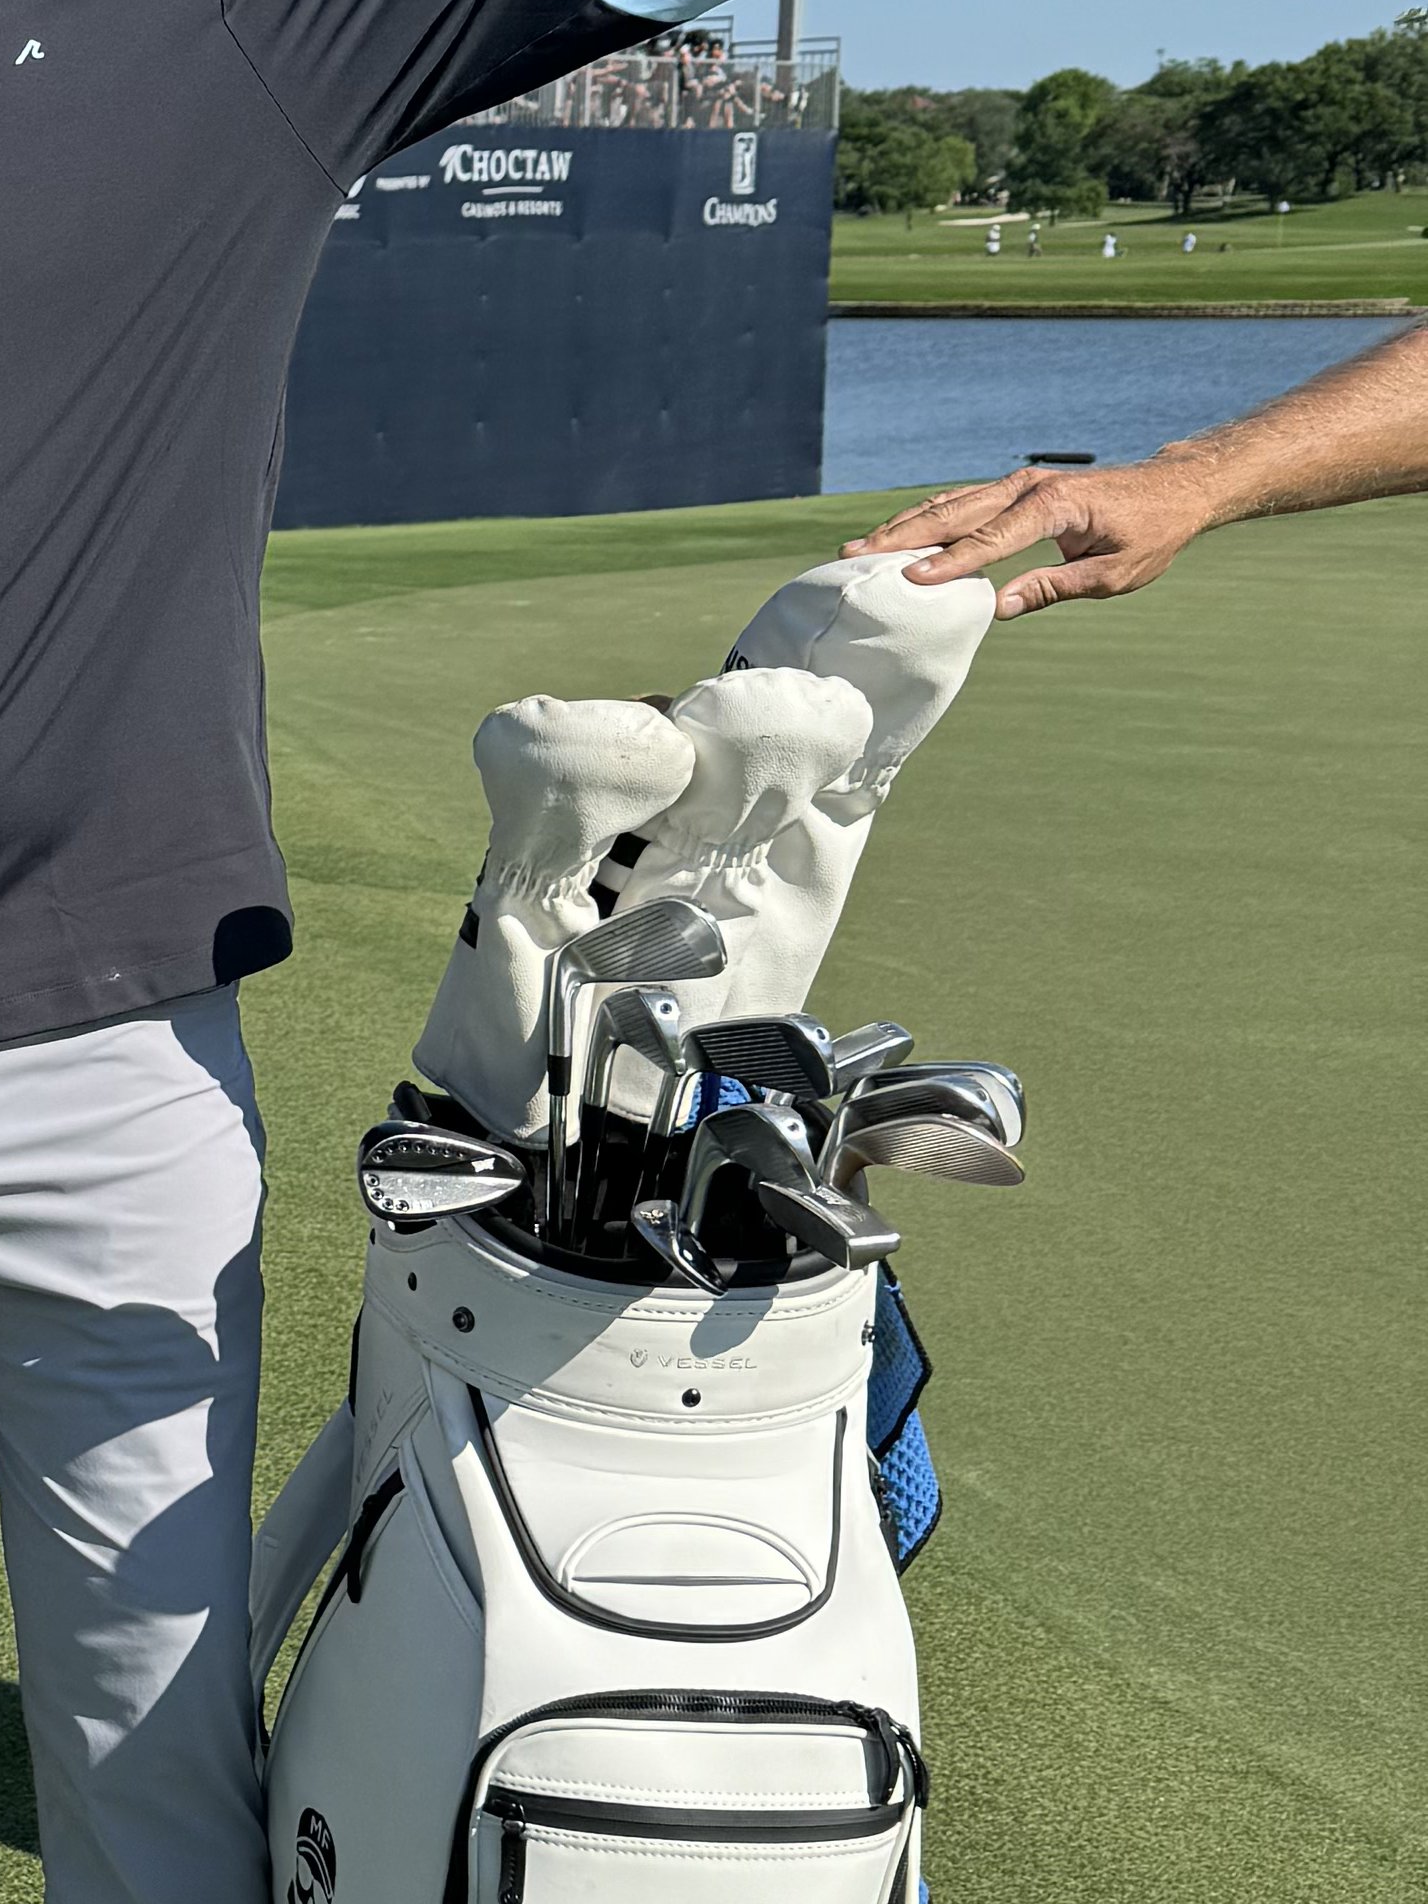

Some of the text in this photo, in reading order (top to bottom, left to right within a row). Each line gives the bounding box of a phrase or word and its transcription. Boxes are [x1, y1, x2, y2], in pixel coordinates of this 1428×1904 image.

[452, 144, 574, 182] CHOCTAW
[657, 1355, 758, 1370] VESSEL
[309, 1815, 331, 1851] MF
